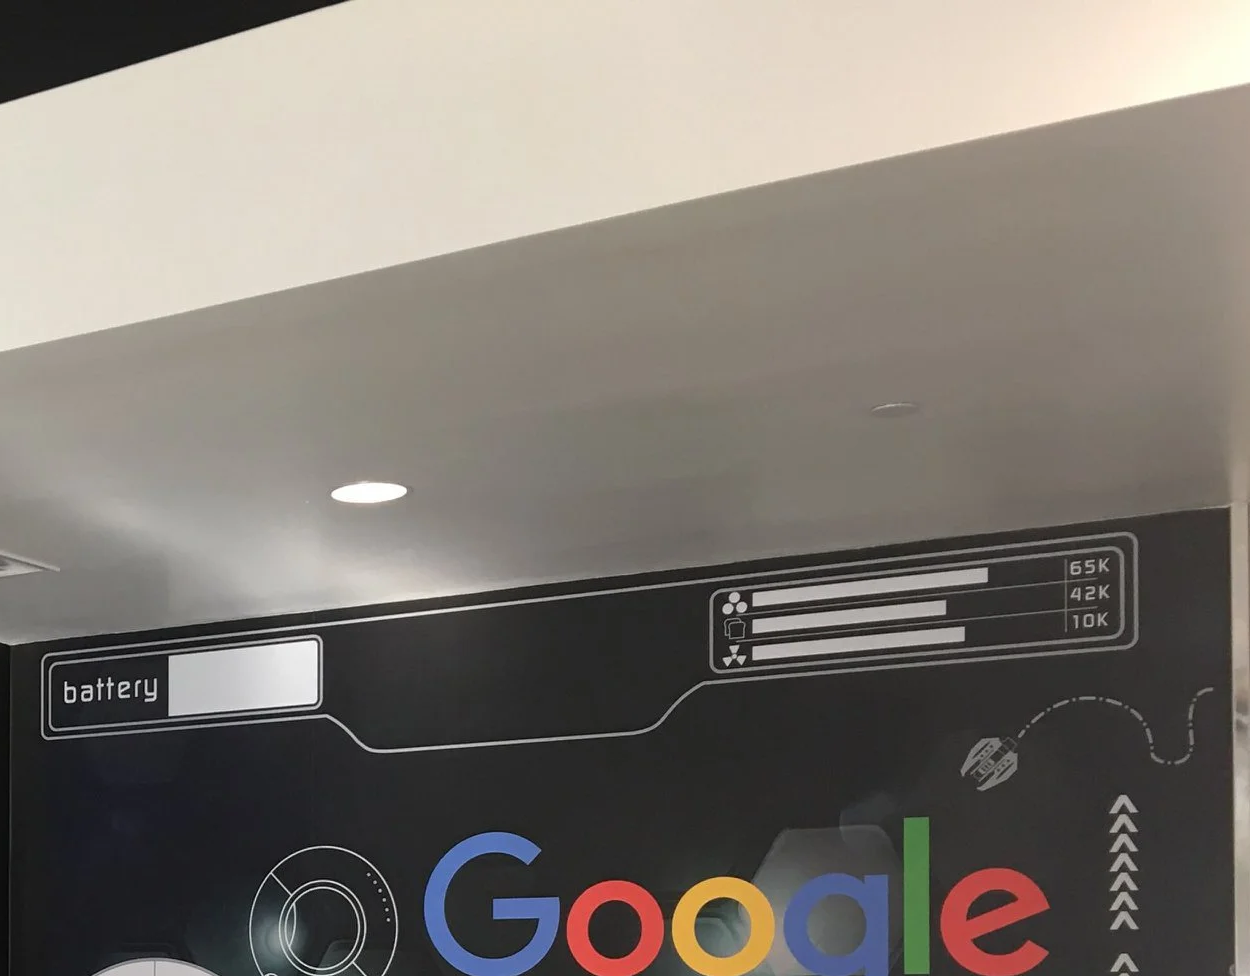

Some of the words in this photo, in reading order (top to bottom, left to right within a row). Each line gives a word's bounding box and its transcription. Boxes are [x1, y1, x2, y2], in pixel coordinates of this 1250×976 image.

[1070, 557, 1110, 576] 65K
[1070, 584, 1110, 601] 42K
[1072, 611, 1109, 629] 10K
[63, 676, 158, 704] battery
